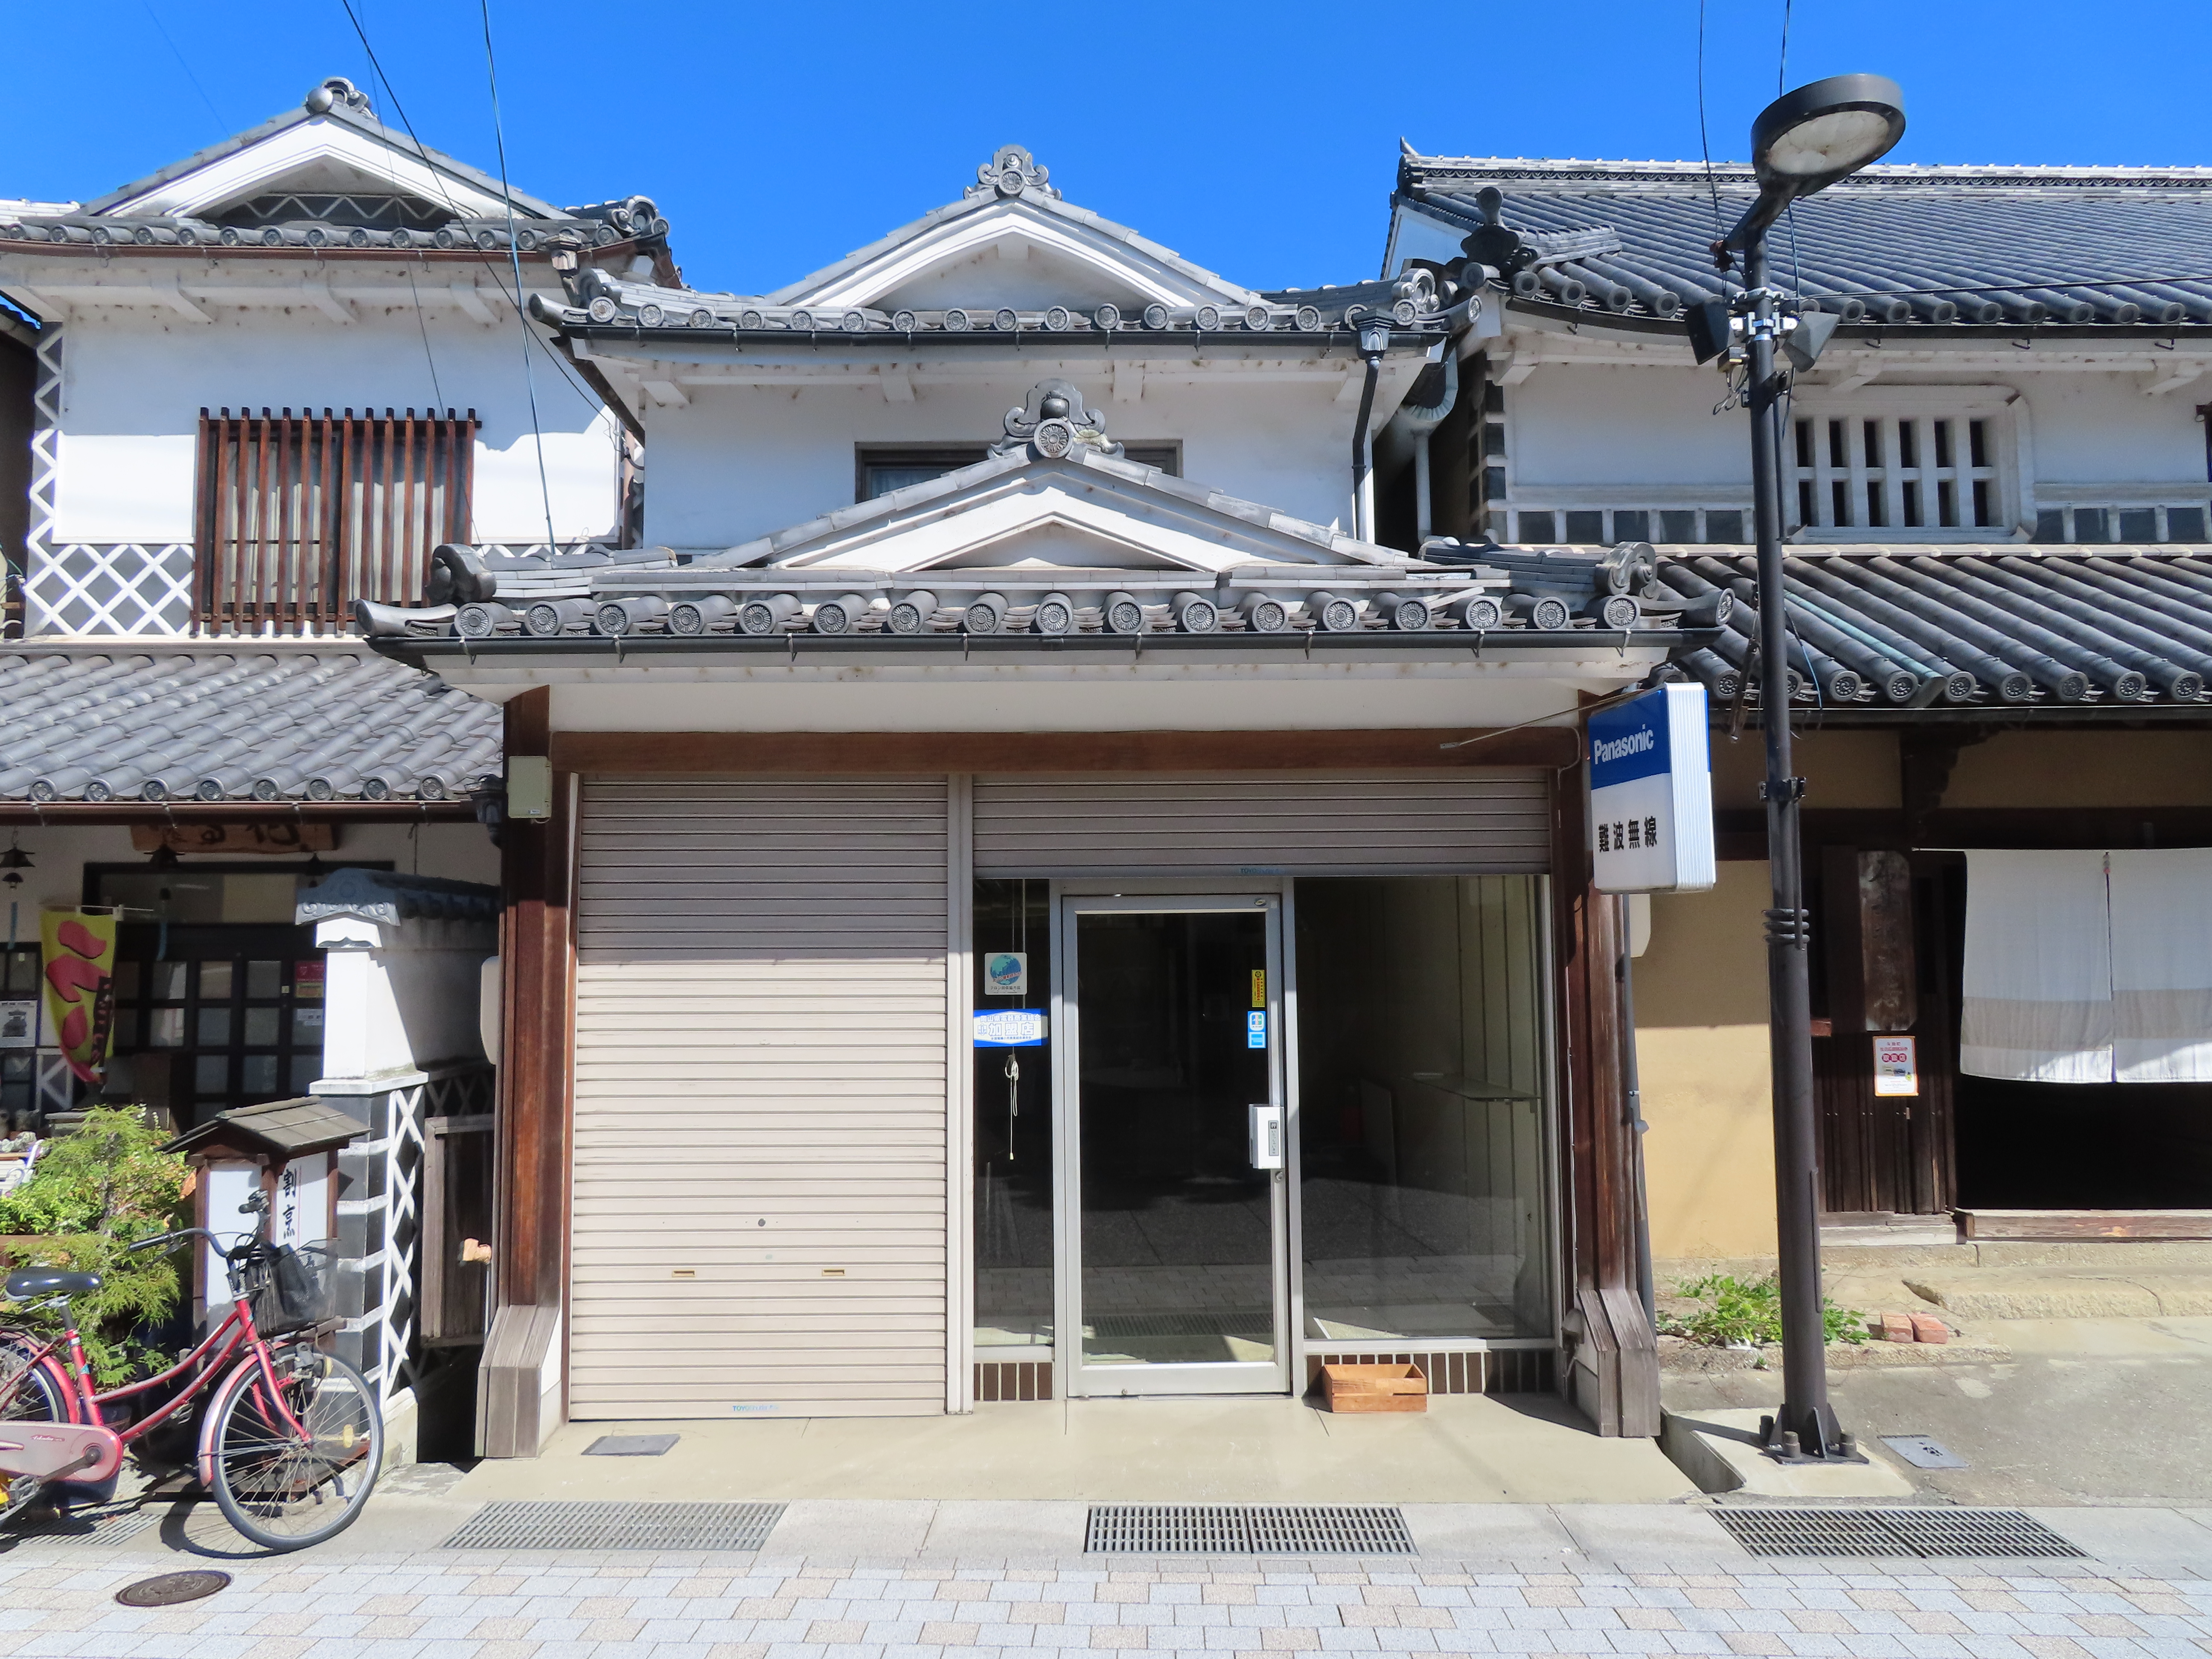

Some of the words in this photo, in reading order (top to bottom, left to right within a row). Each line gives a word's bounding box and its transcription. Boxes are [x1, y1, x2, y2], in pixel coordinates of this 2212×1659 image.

[1594, 724, 1654, 765] Panasonic
[1598, 815, 1658, 853] 難波無線
[988, 1022, 1034, 1036] 加盟店
[282, 1167, 297, 1240] 割烹
